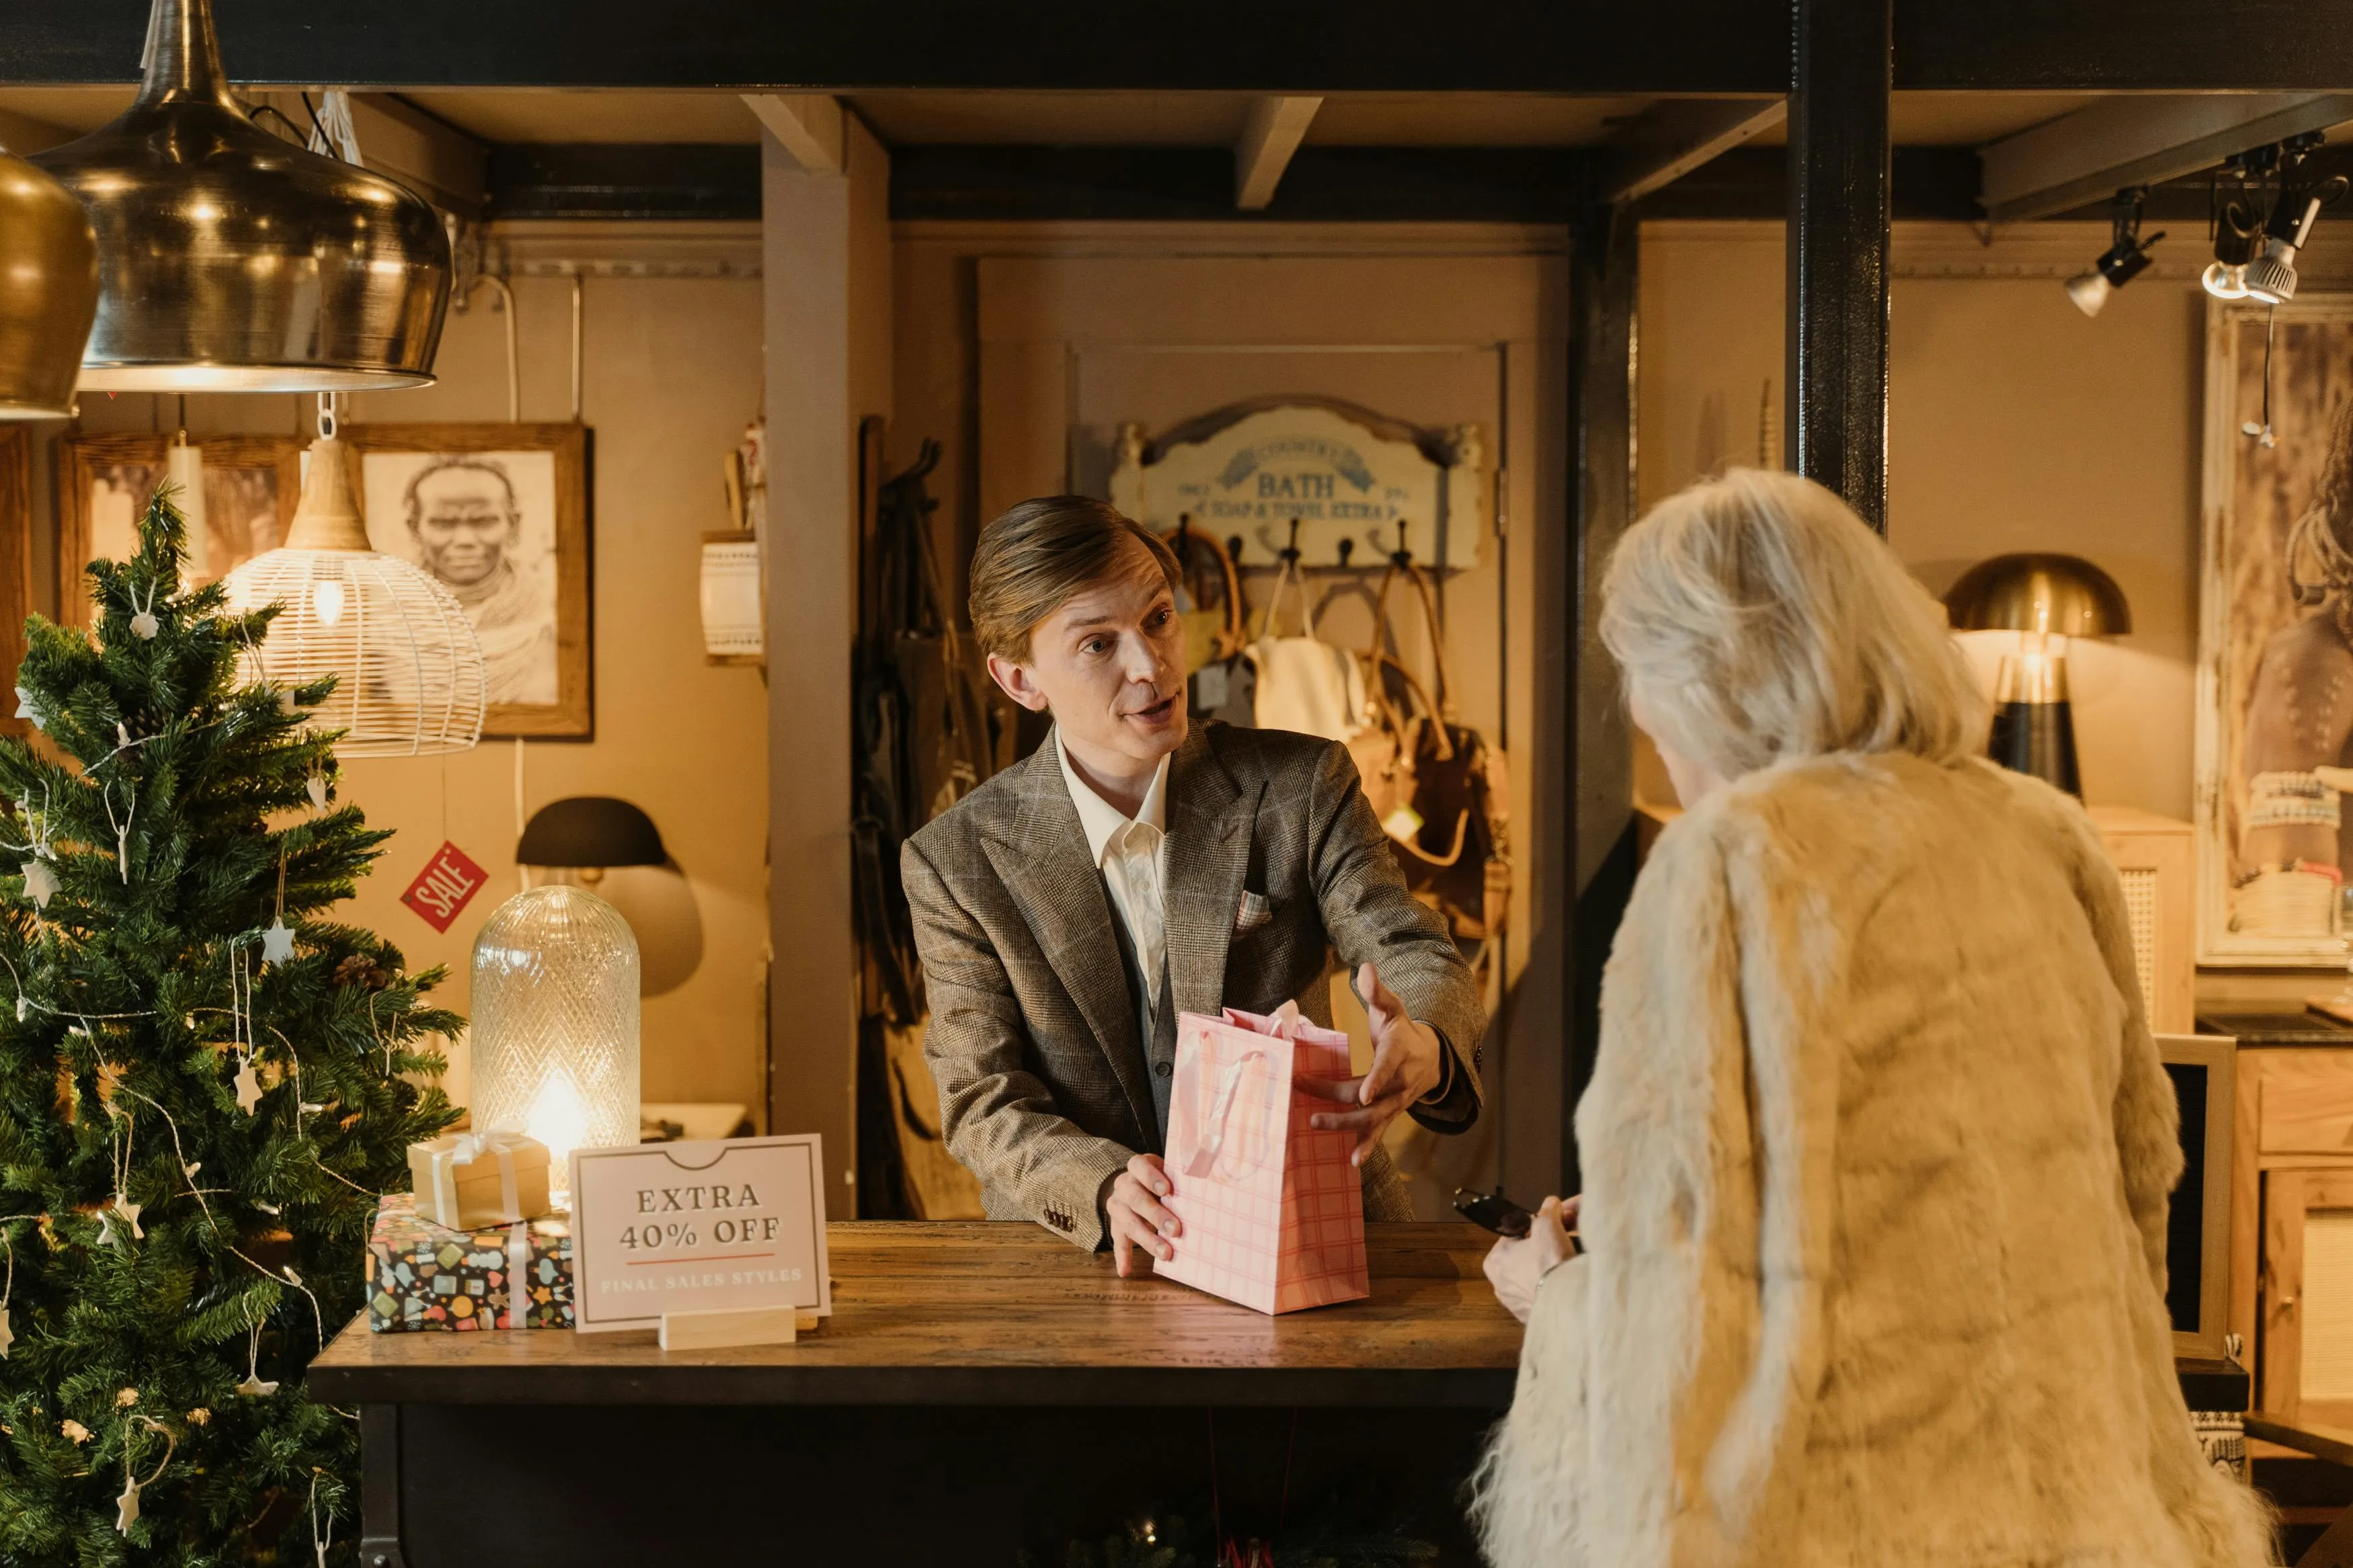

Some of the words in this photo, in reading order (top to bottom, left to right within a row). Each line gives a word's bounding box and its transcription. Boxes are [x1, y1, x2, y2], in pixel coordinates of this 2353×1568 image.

[1257, 472, 1334, 498] BATH
[415, 856, 476, 919] SALE
[636, 1184, 761, 1213] EXTRA
[619, 1222, 697, 1249] 40%
[713, 1217, 781, 1243] OFF
[601, 1277, 659, 1293] FINAL
[665, 1274, 725, 1290] SALES
[731, 1268, 802, 1285] STYLES
